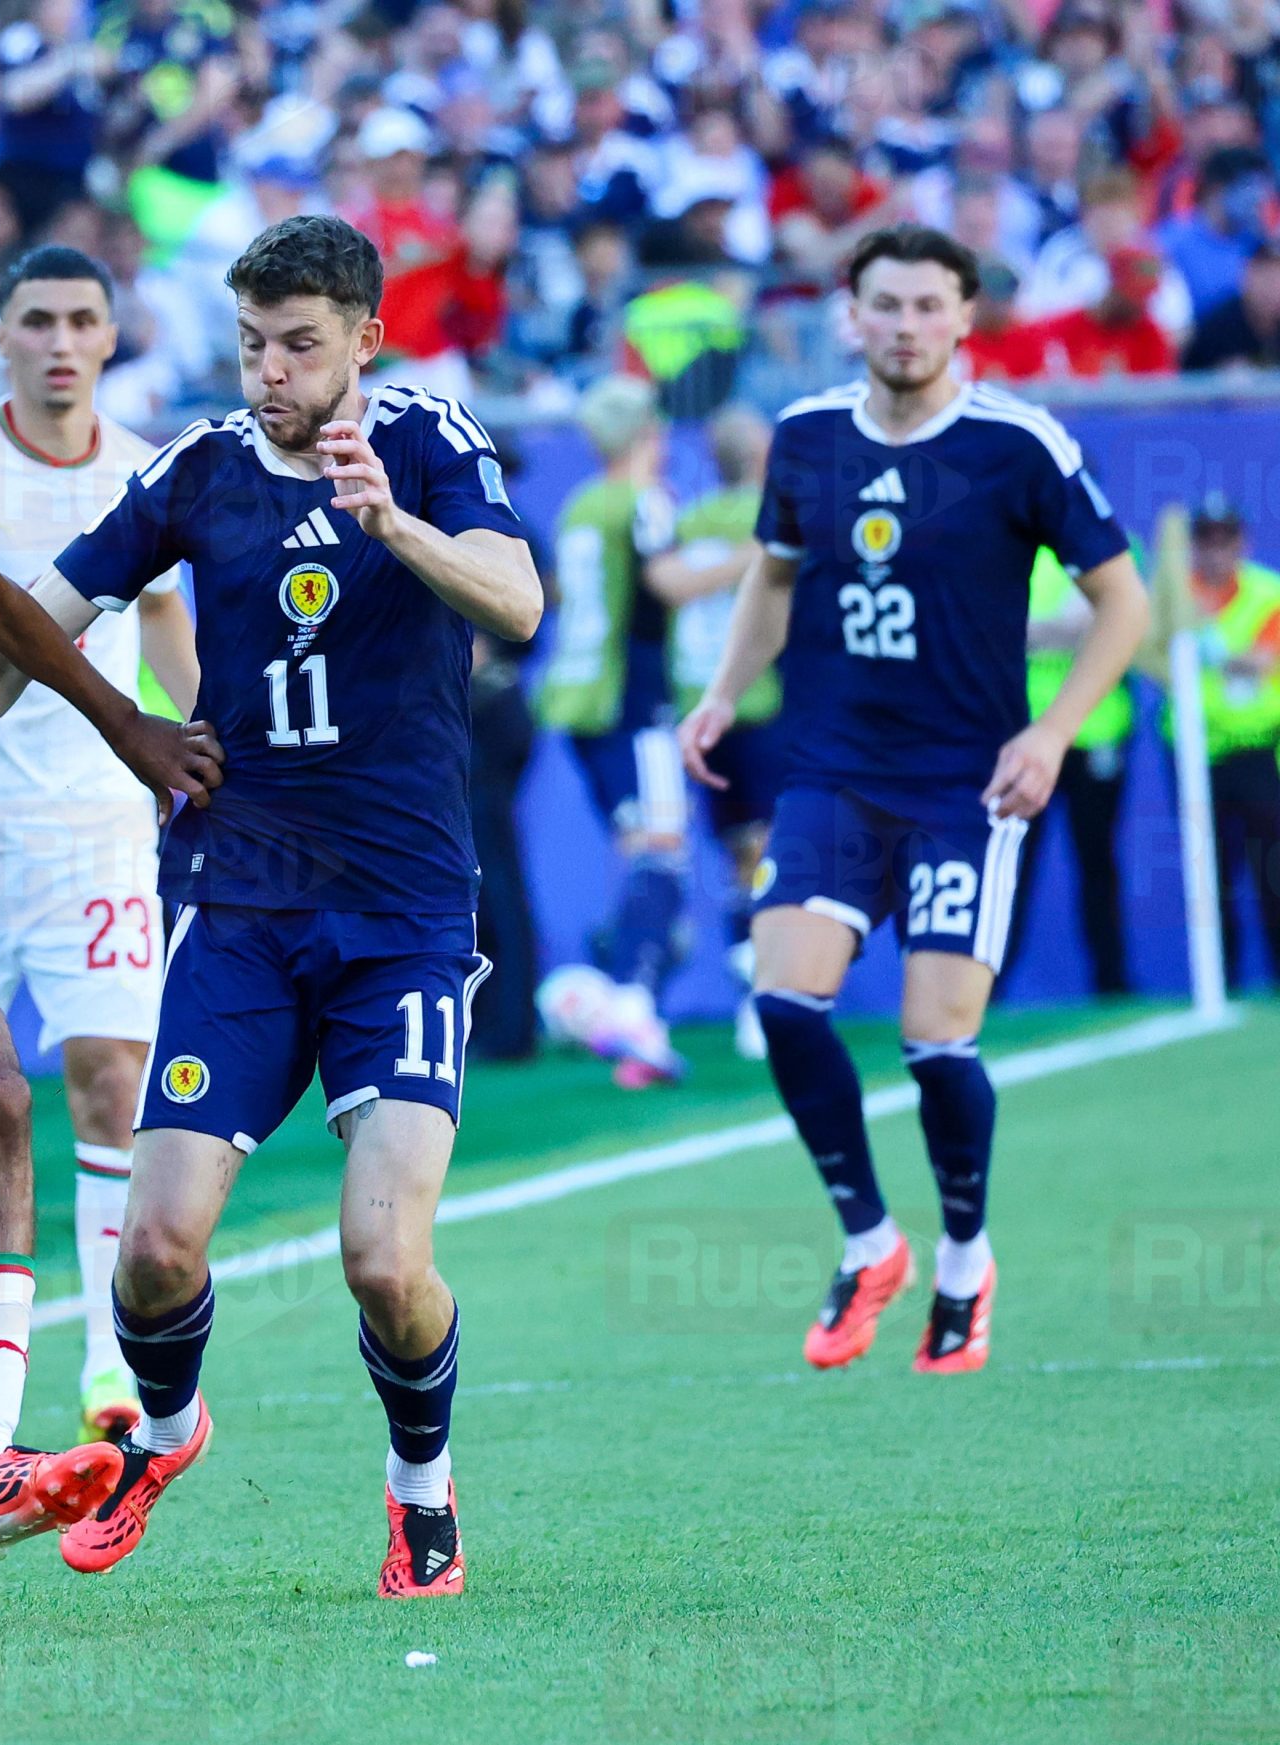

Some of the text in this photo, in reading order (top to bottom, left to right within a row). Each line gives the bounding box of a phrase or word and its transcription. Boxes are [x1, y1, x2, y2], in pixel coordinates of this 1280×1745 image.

[838, 582, 917, 660] 22
[263, 654, 339, 747] 11
[84, 897, 150, 969] 23
[908, 860, 978, 936] 22
[394, 991, 456, 1088] 11
[370, 1199, 393, 1209] JOY
